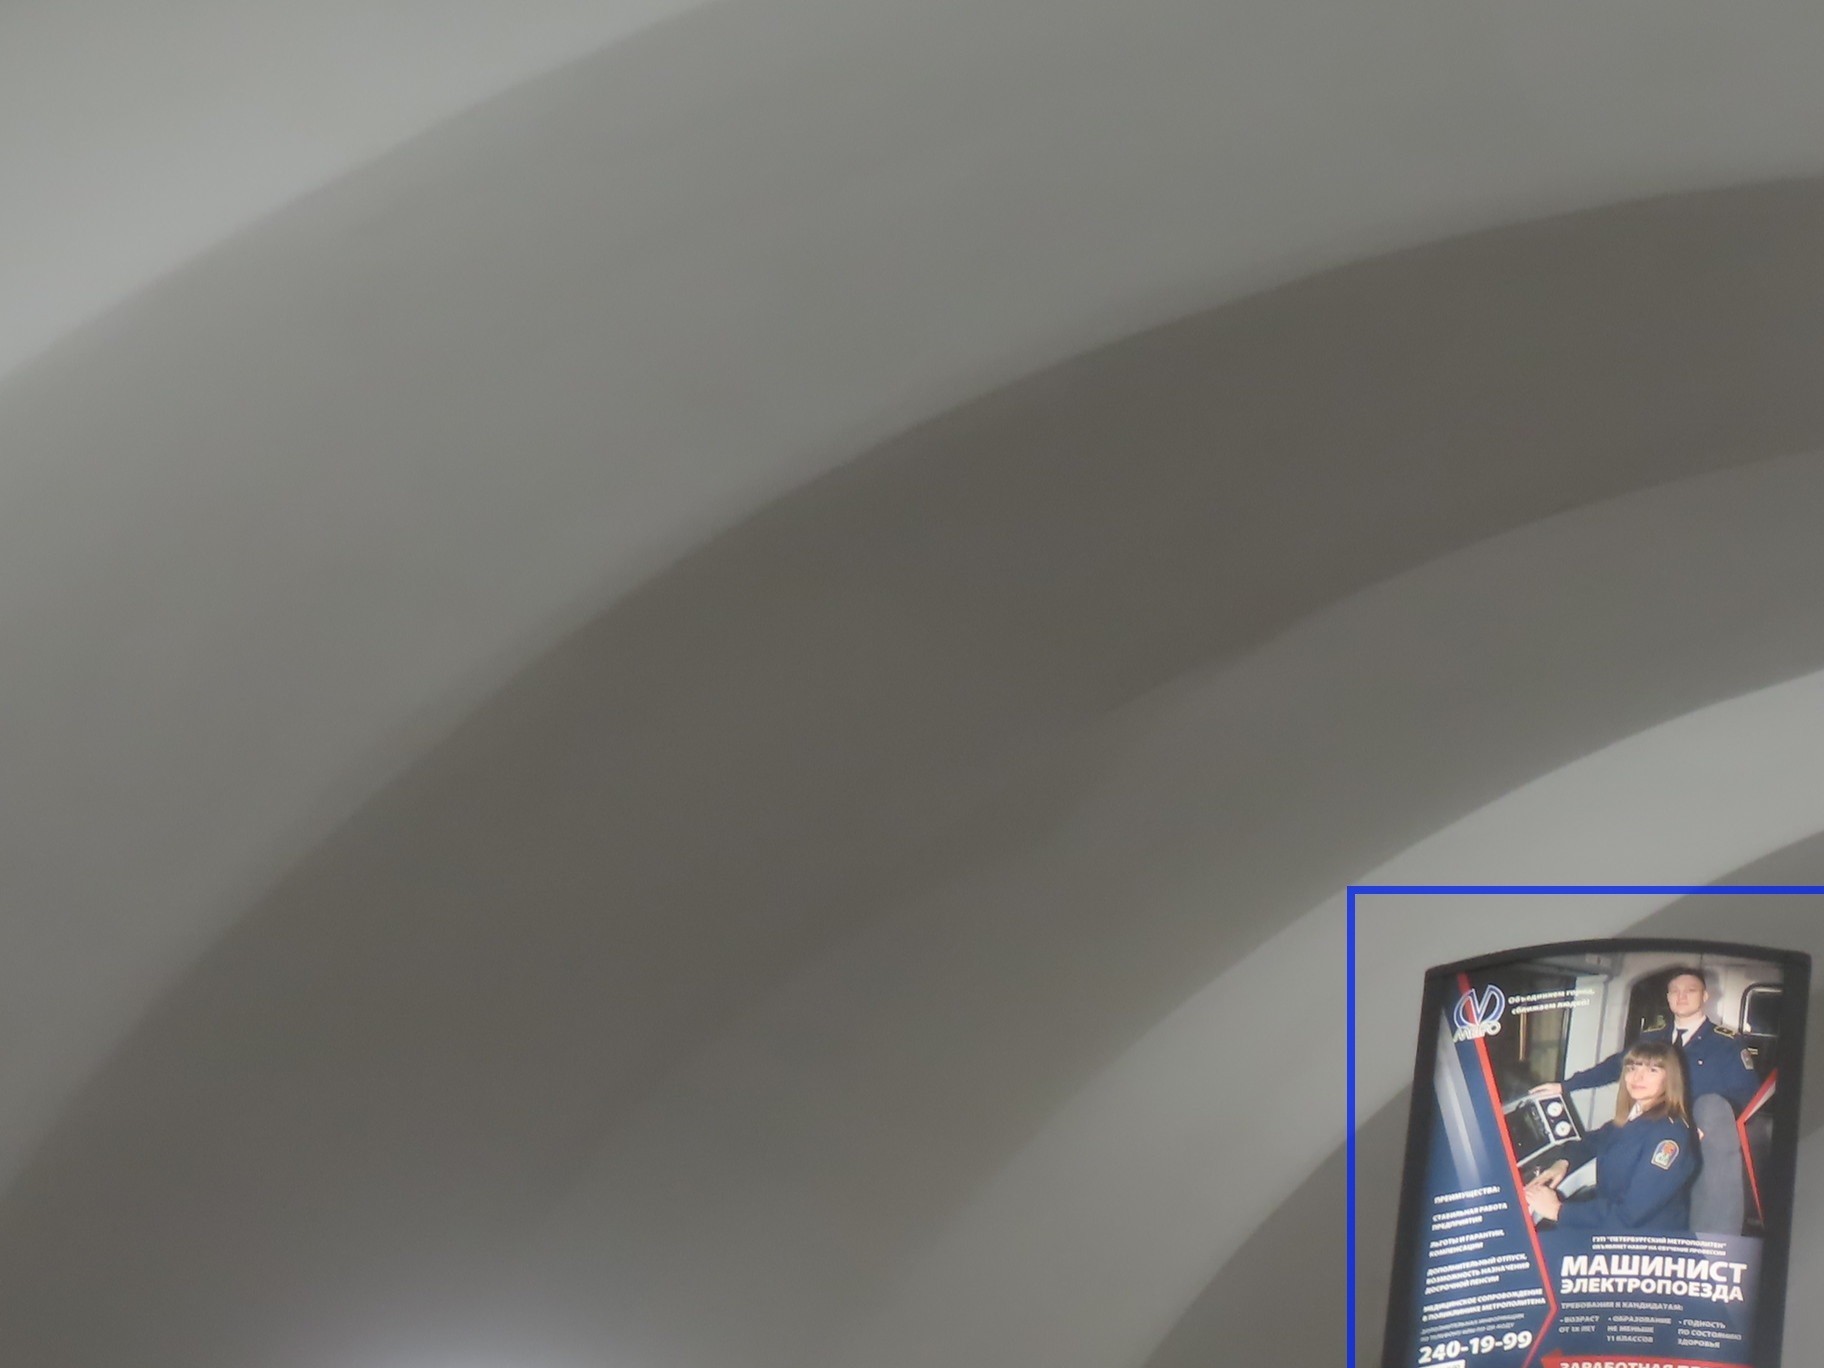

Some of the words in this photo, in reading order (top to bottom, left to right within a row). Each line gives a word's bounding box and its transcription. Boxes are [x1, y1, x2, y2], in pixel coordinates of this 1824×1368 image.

[1479, 1202, 1508, 1213] РАБОТА
[1560, 1254, 1747, 1284] МАШИНИСТ
[1560, 1277, 1744, 1303] ЭЛЕКТРОПОЕЗДА
[1418, 1330, 1532, 1364] 240-19-99
